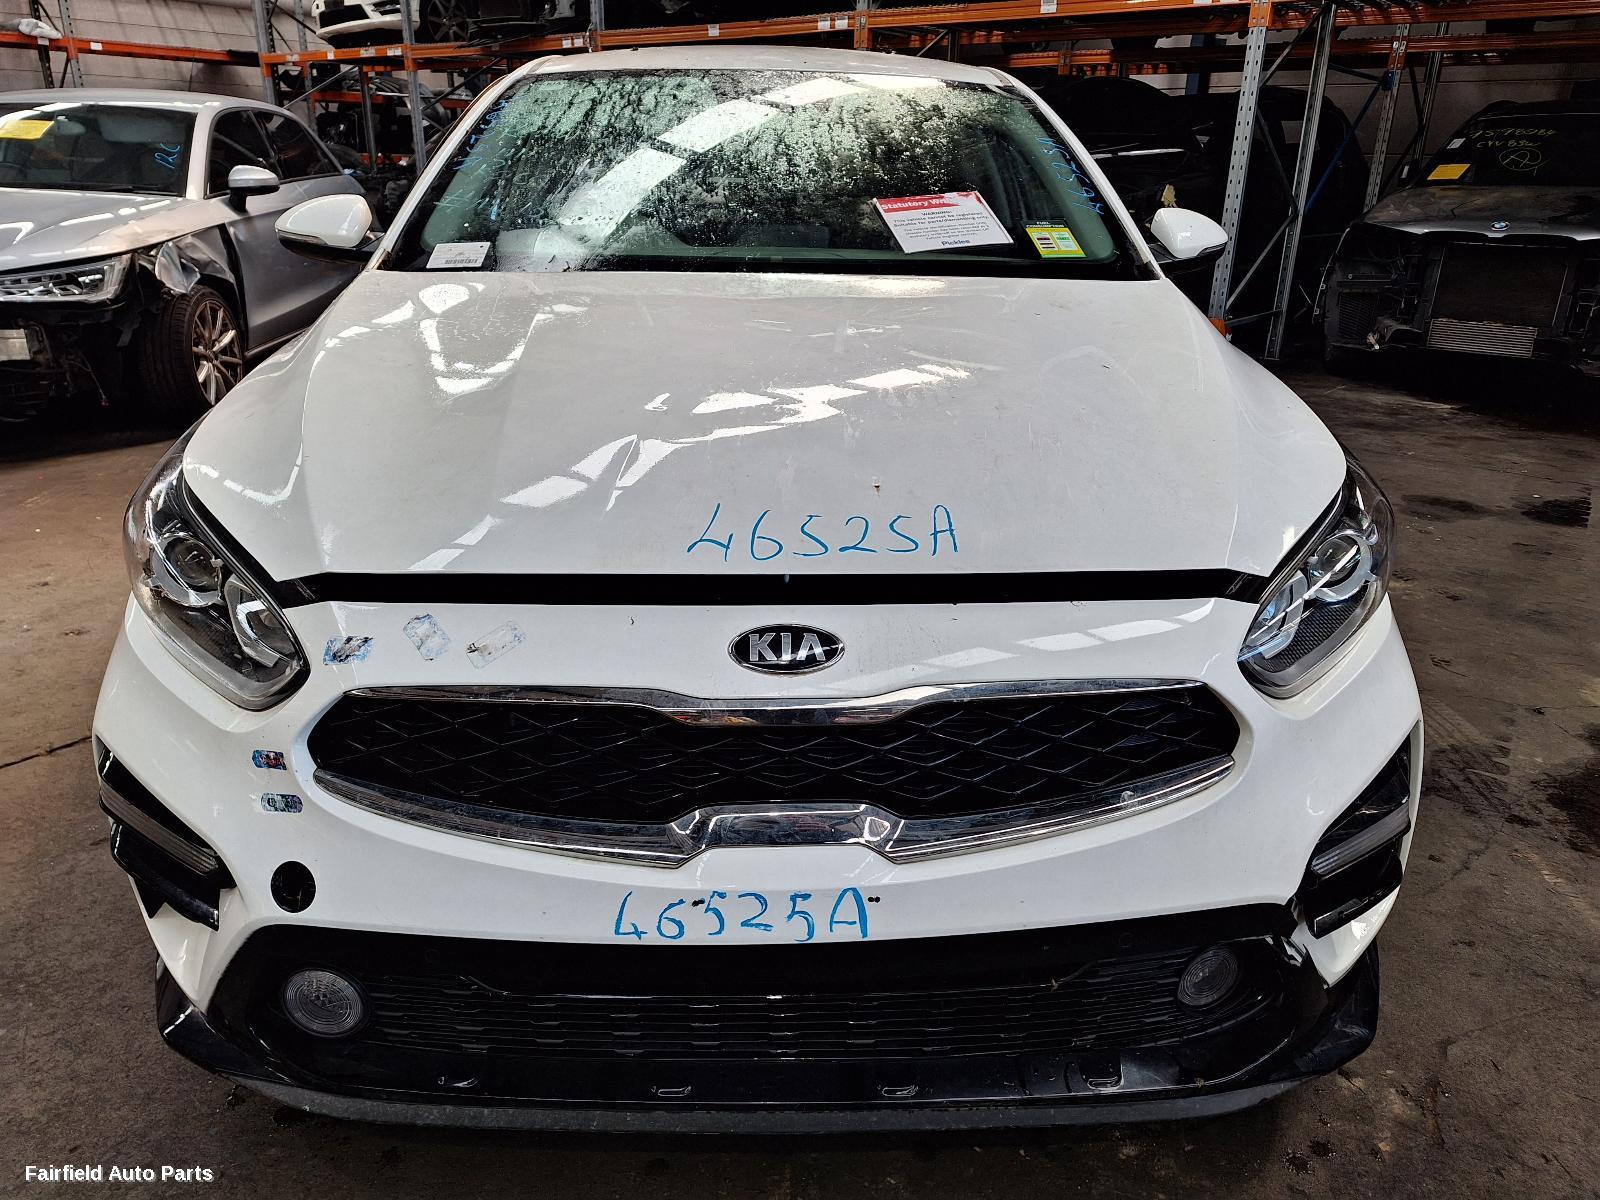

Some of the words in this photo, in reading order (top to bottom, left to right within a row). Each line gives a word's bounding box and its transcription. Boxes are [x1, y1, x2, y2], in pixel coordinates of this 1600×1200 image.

[881, 200, 928, 210] Statutory
[941, 239, 971, 247] Pickles
[686, 502, 959, 562] 46525A
[748, 632, 826, 662] KIA
[613, 887, 869, 943] 46525A
